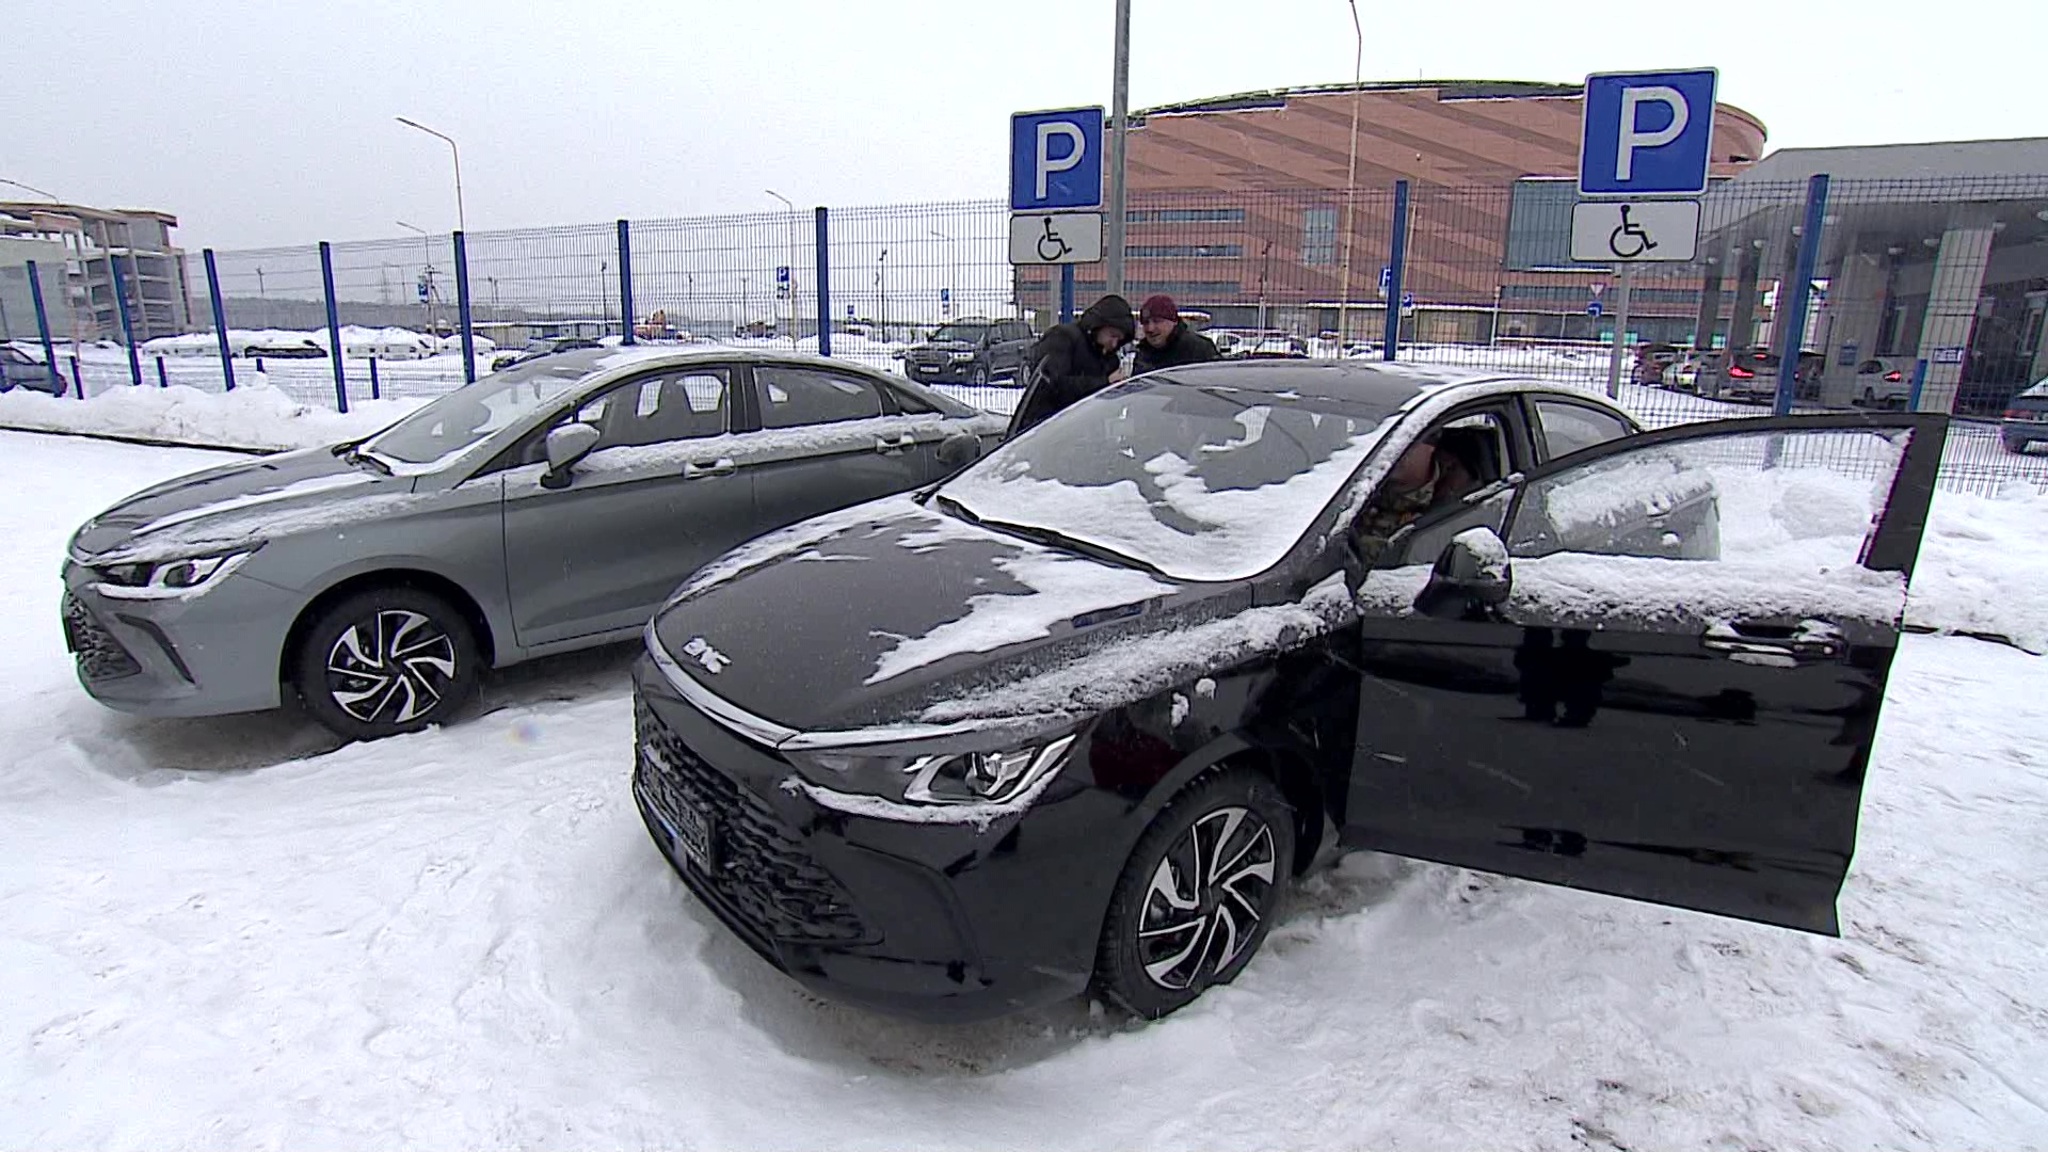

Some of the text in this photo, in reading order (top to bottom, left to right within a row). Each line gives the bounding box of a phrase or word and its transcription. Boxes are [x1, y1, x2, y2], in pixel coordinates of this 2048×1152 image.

[1036, 121, 1085, 200] P
[1615, 86, 1689, 181] P
[779, 269, 786, 280] P
